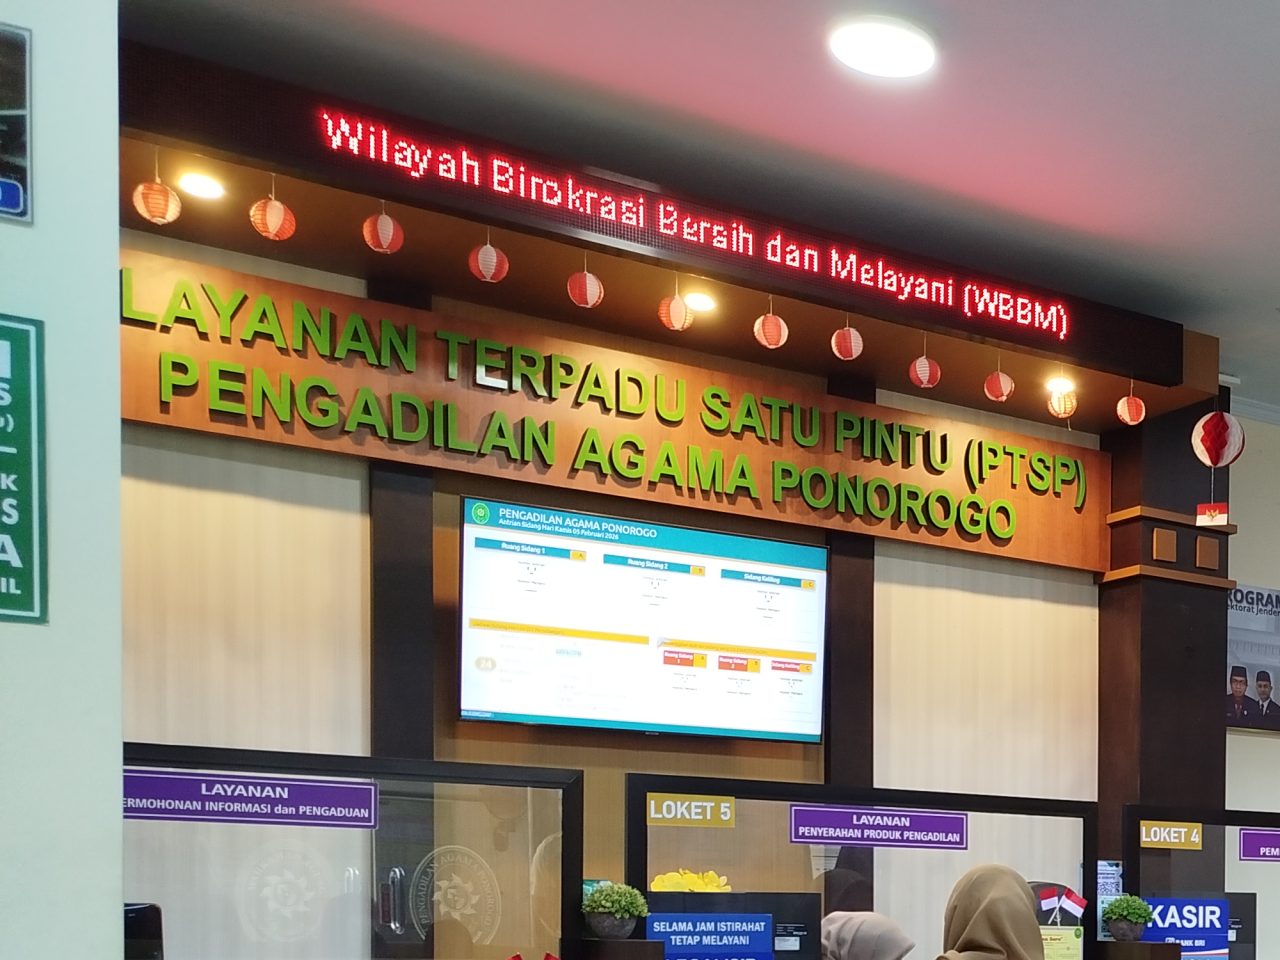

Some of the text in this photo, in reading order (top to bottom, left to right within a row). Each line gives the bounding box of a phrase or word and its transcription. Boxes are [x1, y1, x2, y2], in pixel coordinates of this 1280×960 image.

[322, 112, 1069, 340] Wilayah Birokrasi Bersih dan Melayani (WBBM)
[436, 329, 687, 423] TERPADU
[700, 384, 821, 449] SATU
[833, 410, 952, 474] PINTU
[964, 437, 1088, 509] (PTSP)
[160, 352, 1018, 540] PENGADILAN AGAMA PONOROGO
[499, 508, 657, 538] PENGADILAN AGAMA PONOROGO
[521, 521, 541, 531] Sidang
[542, 523, 554, 532] Hari
[201, 783, 289, 799] LAYANAN
[205, 801, 271, 814] INFORMASI
[274, 804, 296, 815] dan
[298, 806, 369, 818] PENGADUAN
[649, 799, 731, 821] LOKET 5
[852, 814, 911, 827] LAYANAN
[798, 826, 960, 842] PENYERAHAN PRODUK PENGADILAN
[1141, 826, 1200, 844] LOKET 4
[1146, 905, 1221, 928] KASIR
[653, 921, 766, 932] SELAMA JAM ISTIRAHAT
[670, 935, 750, 946] TETAP MELAYANI
